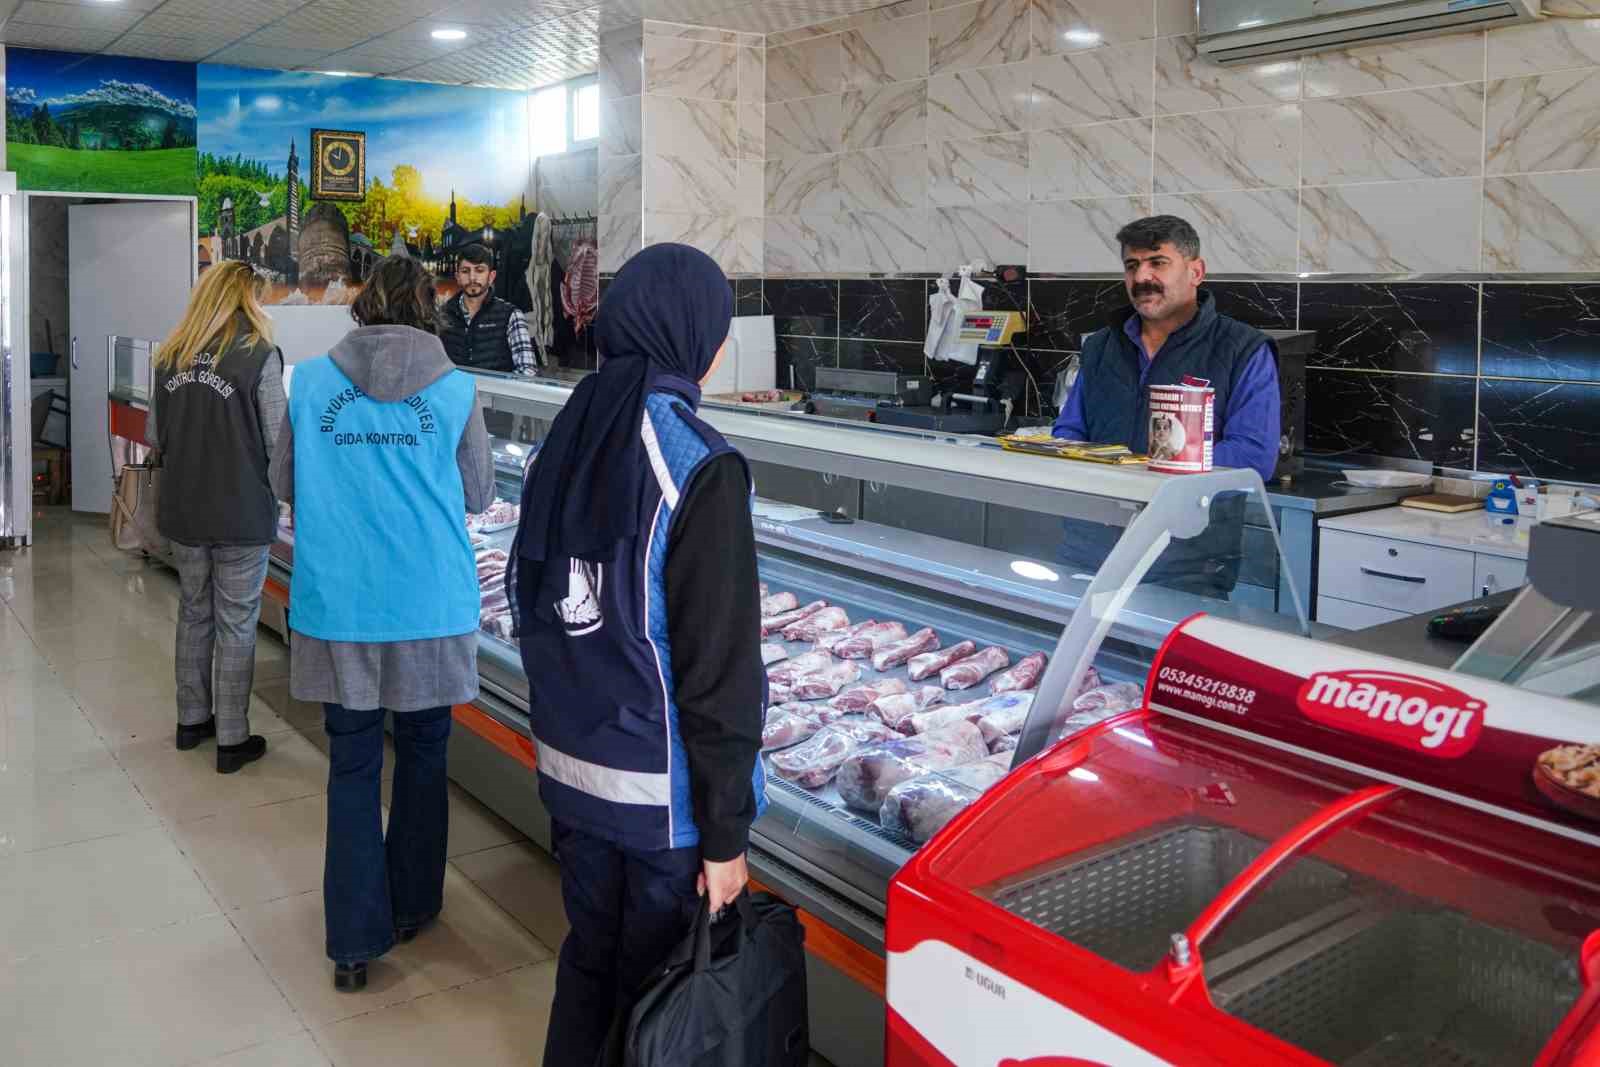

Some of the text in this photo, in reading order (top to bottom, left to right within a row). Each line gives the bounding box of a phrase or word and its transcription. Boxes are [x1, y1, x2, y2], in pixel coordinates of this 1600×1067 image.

[320, 385, 368, 433] BÜYÜKŞE
[334, 432, 421, 446] GIDA KONTROL
[1157, 681, 1249, 715] www.manogi.com.tr
[1159, 666, 1256, 704] 05345213838
[1306, 673, 1481, 749] manogi
